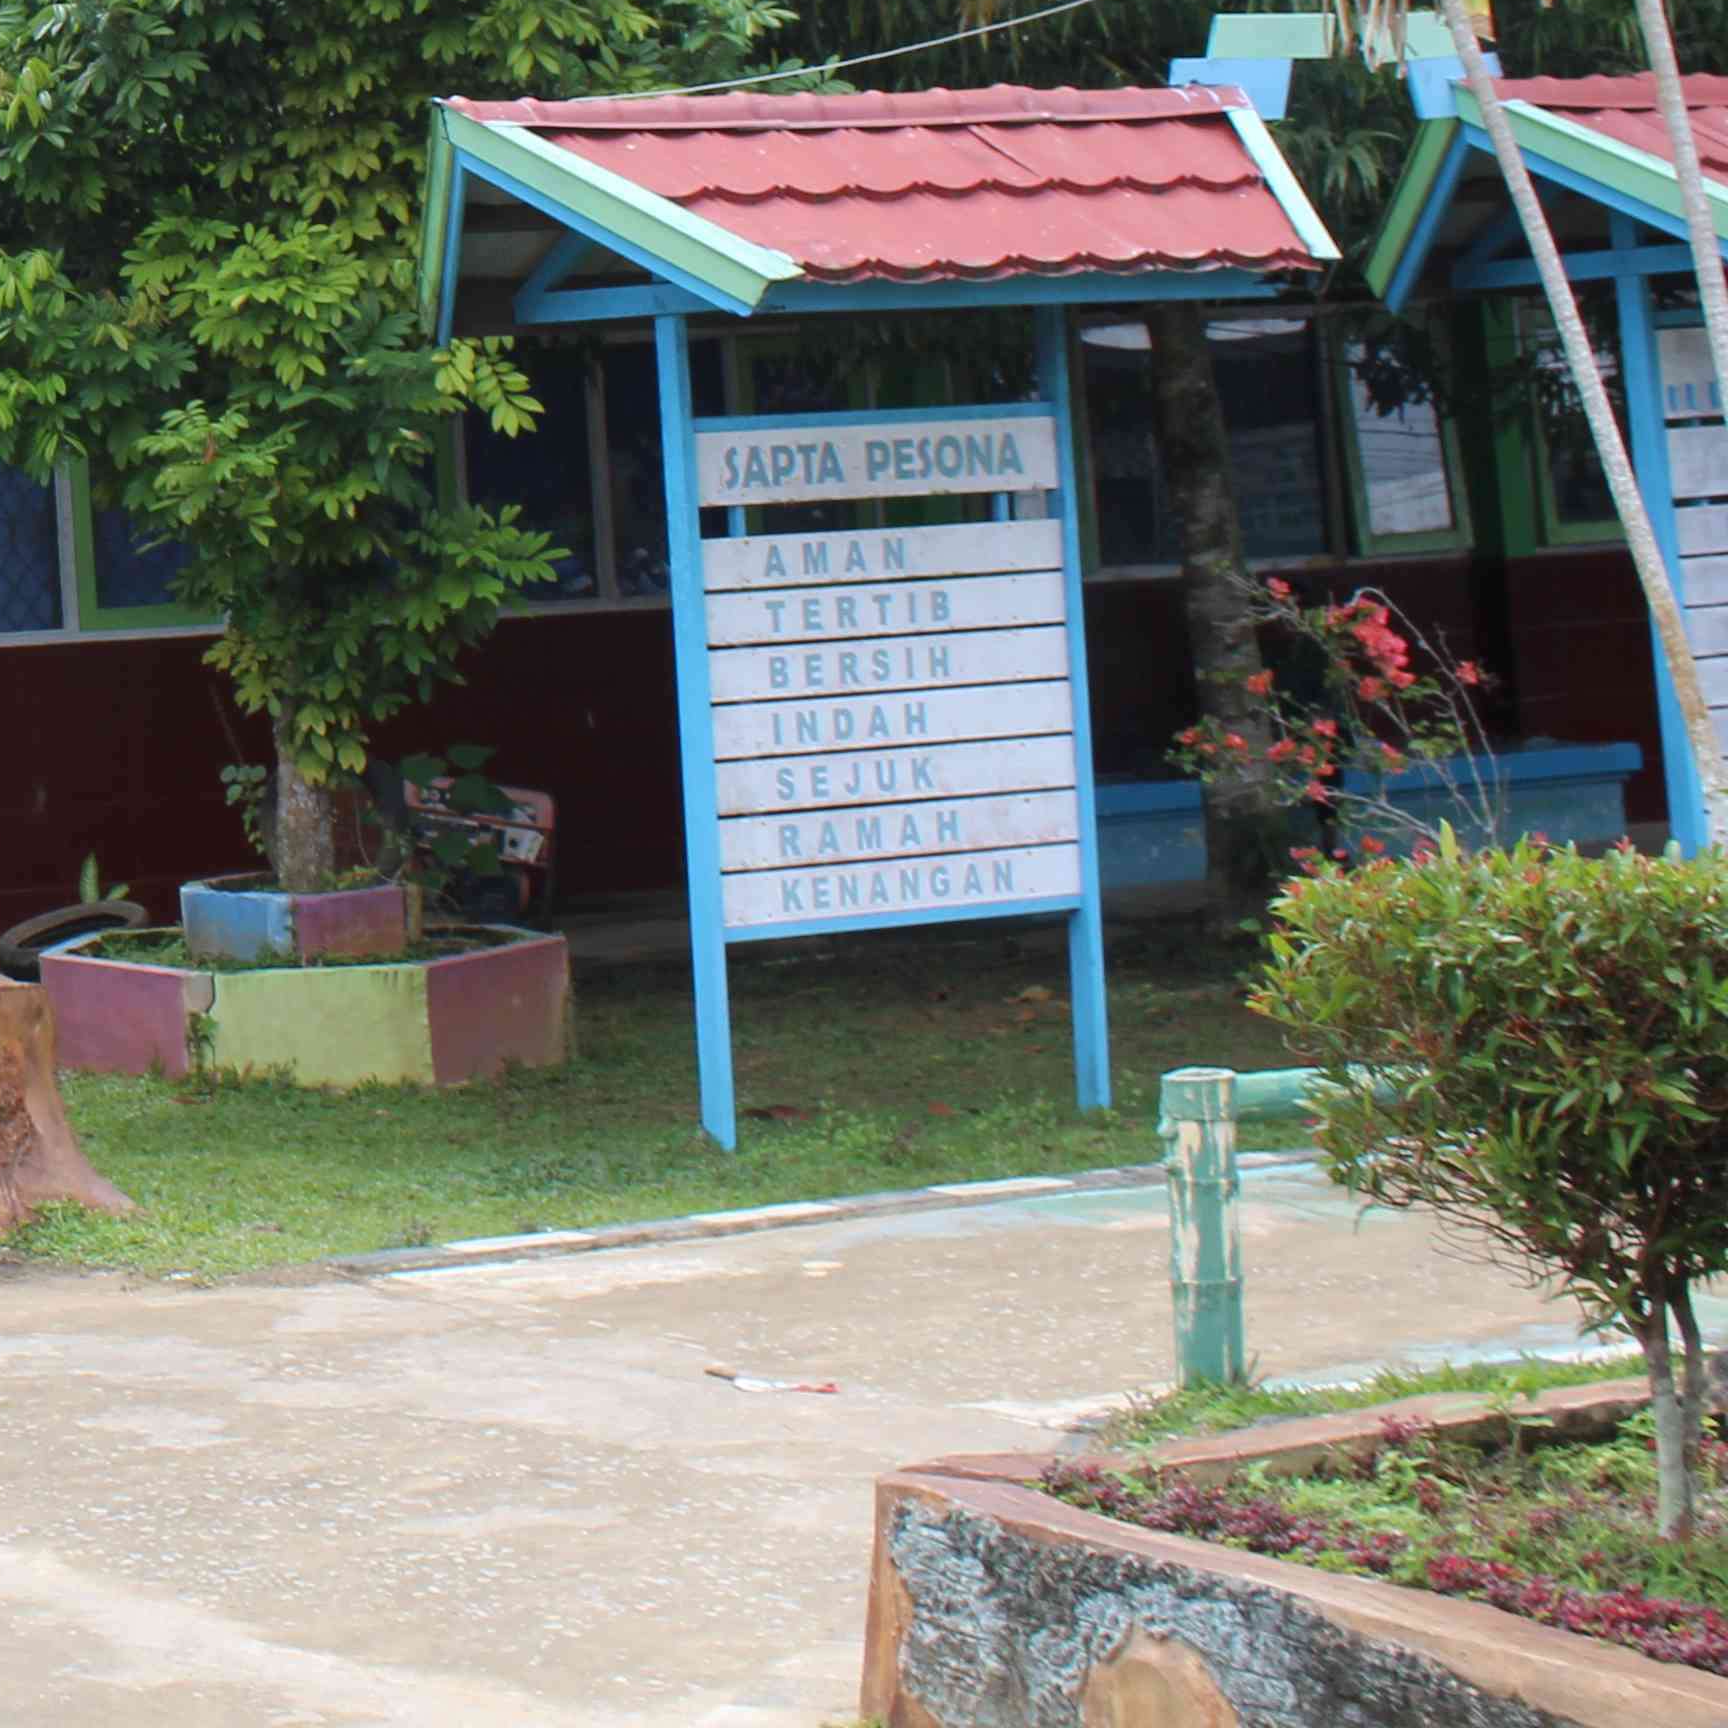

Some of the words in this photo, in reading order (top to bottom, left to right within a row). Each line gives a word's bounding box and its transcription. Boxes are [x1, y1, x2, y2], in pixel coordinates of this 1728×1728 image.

[723, 441, 845, 490] SAPTA
[865, 432, 1024, 482] PESONA
[763, 537, 906, 578] AMAN
[765, 590, 951, 633] TERTIB
[769, 646, 950, 690] BERSIH
[772, 702, 928, 746] INDAH
[775, 756, 935, 801] SEJUK
[778, 810, 960, 859] RAMAH
[781, 860, 1015, 914] KENANGAN
